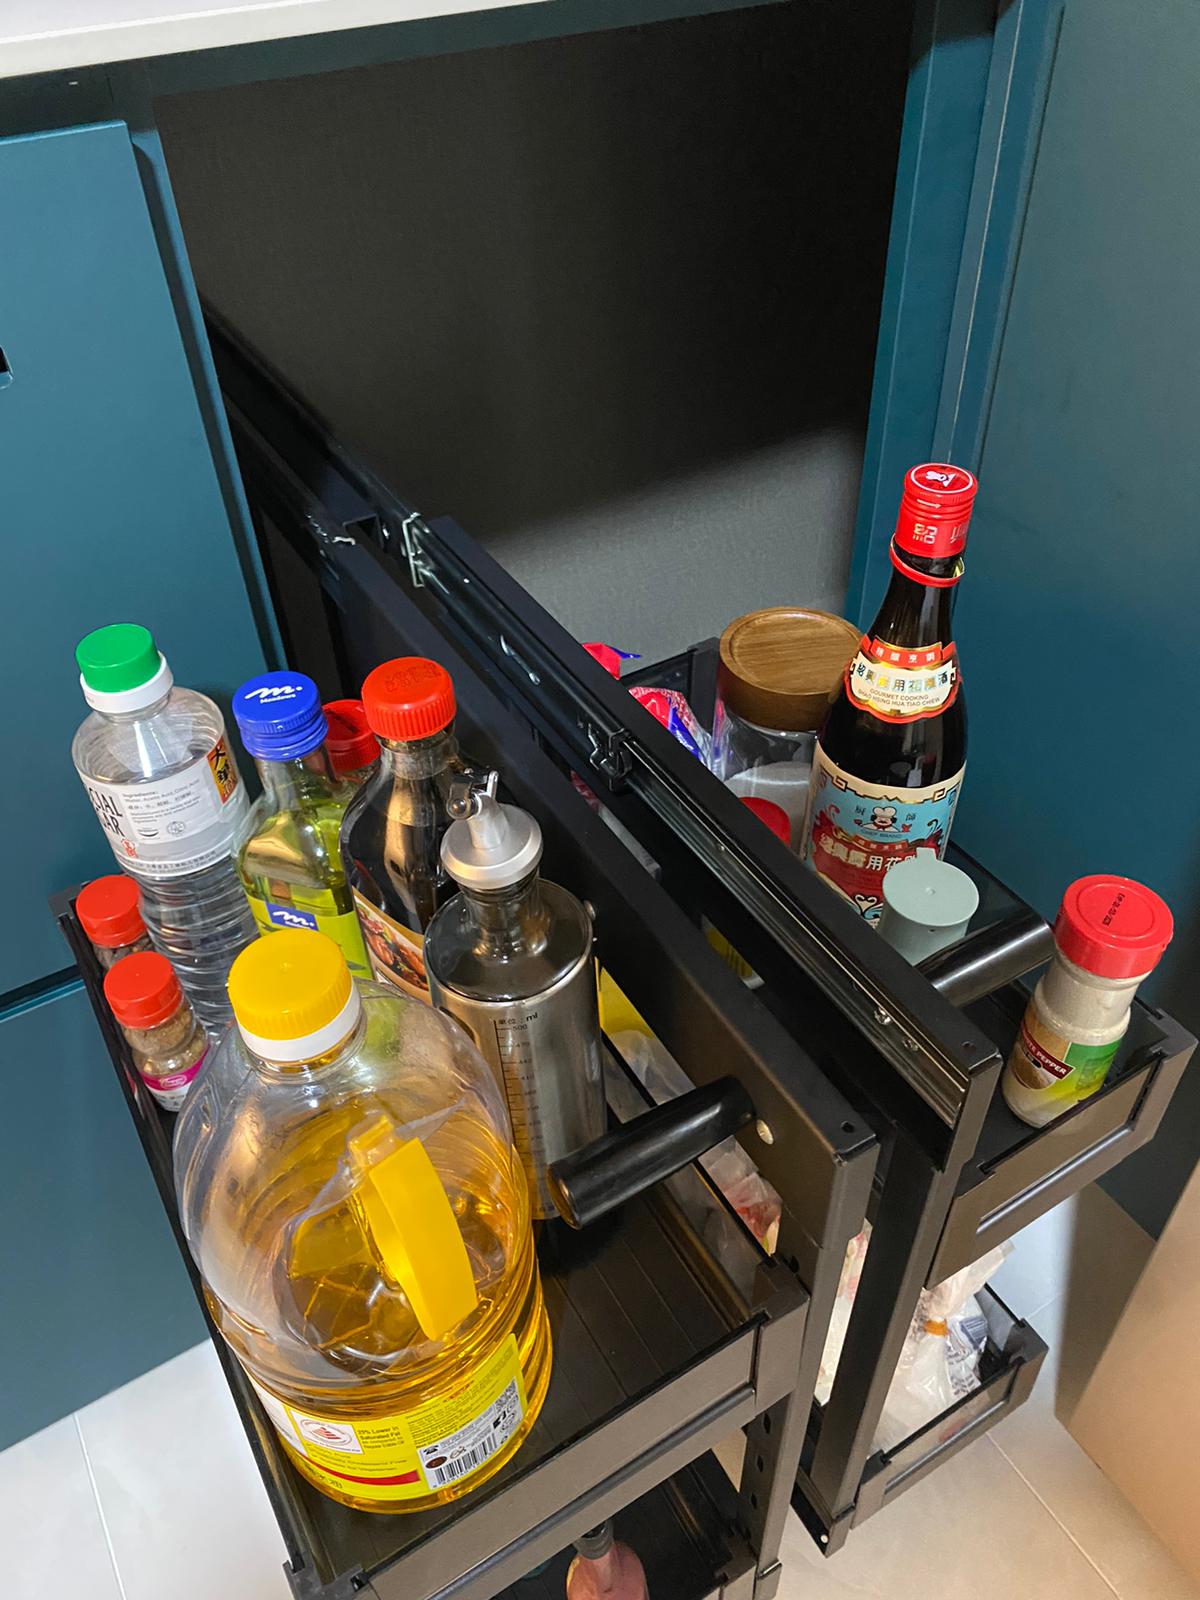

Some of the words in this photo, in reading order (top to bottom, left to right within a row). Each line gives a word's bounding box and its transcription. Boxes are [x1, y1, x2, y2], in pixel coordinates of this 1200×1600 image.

[869, 688, 900, 700] GOURMET
[871, 694, 891, 705] HSING
[921, 697, 941, 706] CHIEW
[1036, 1050, 1067, 1075] PEPPER
